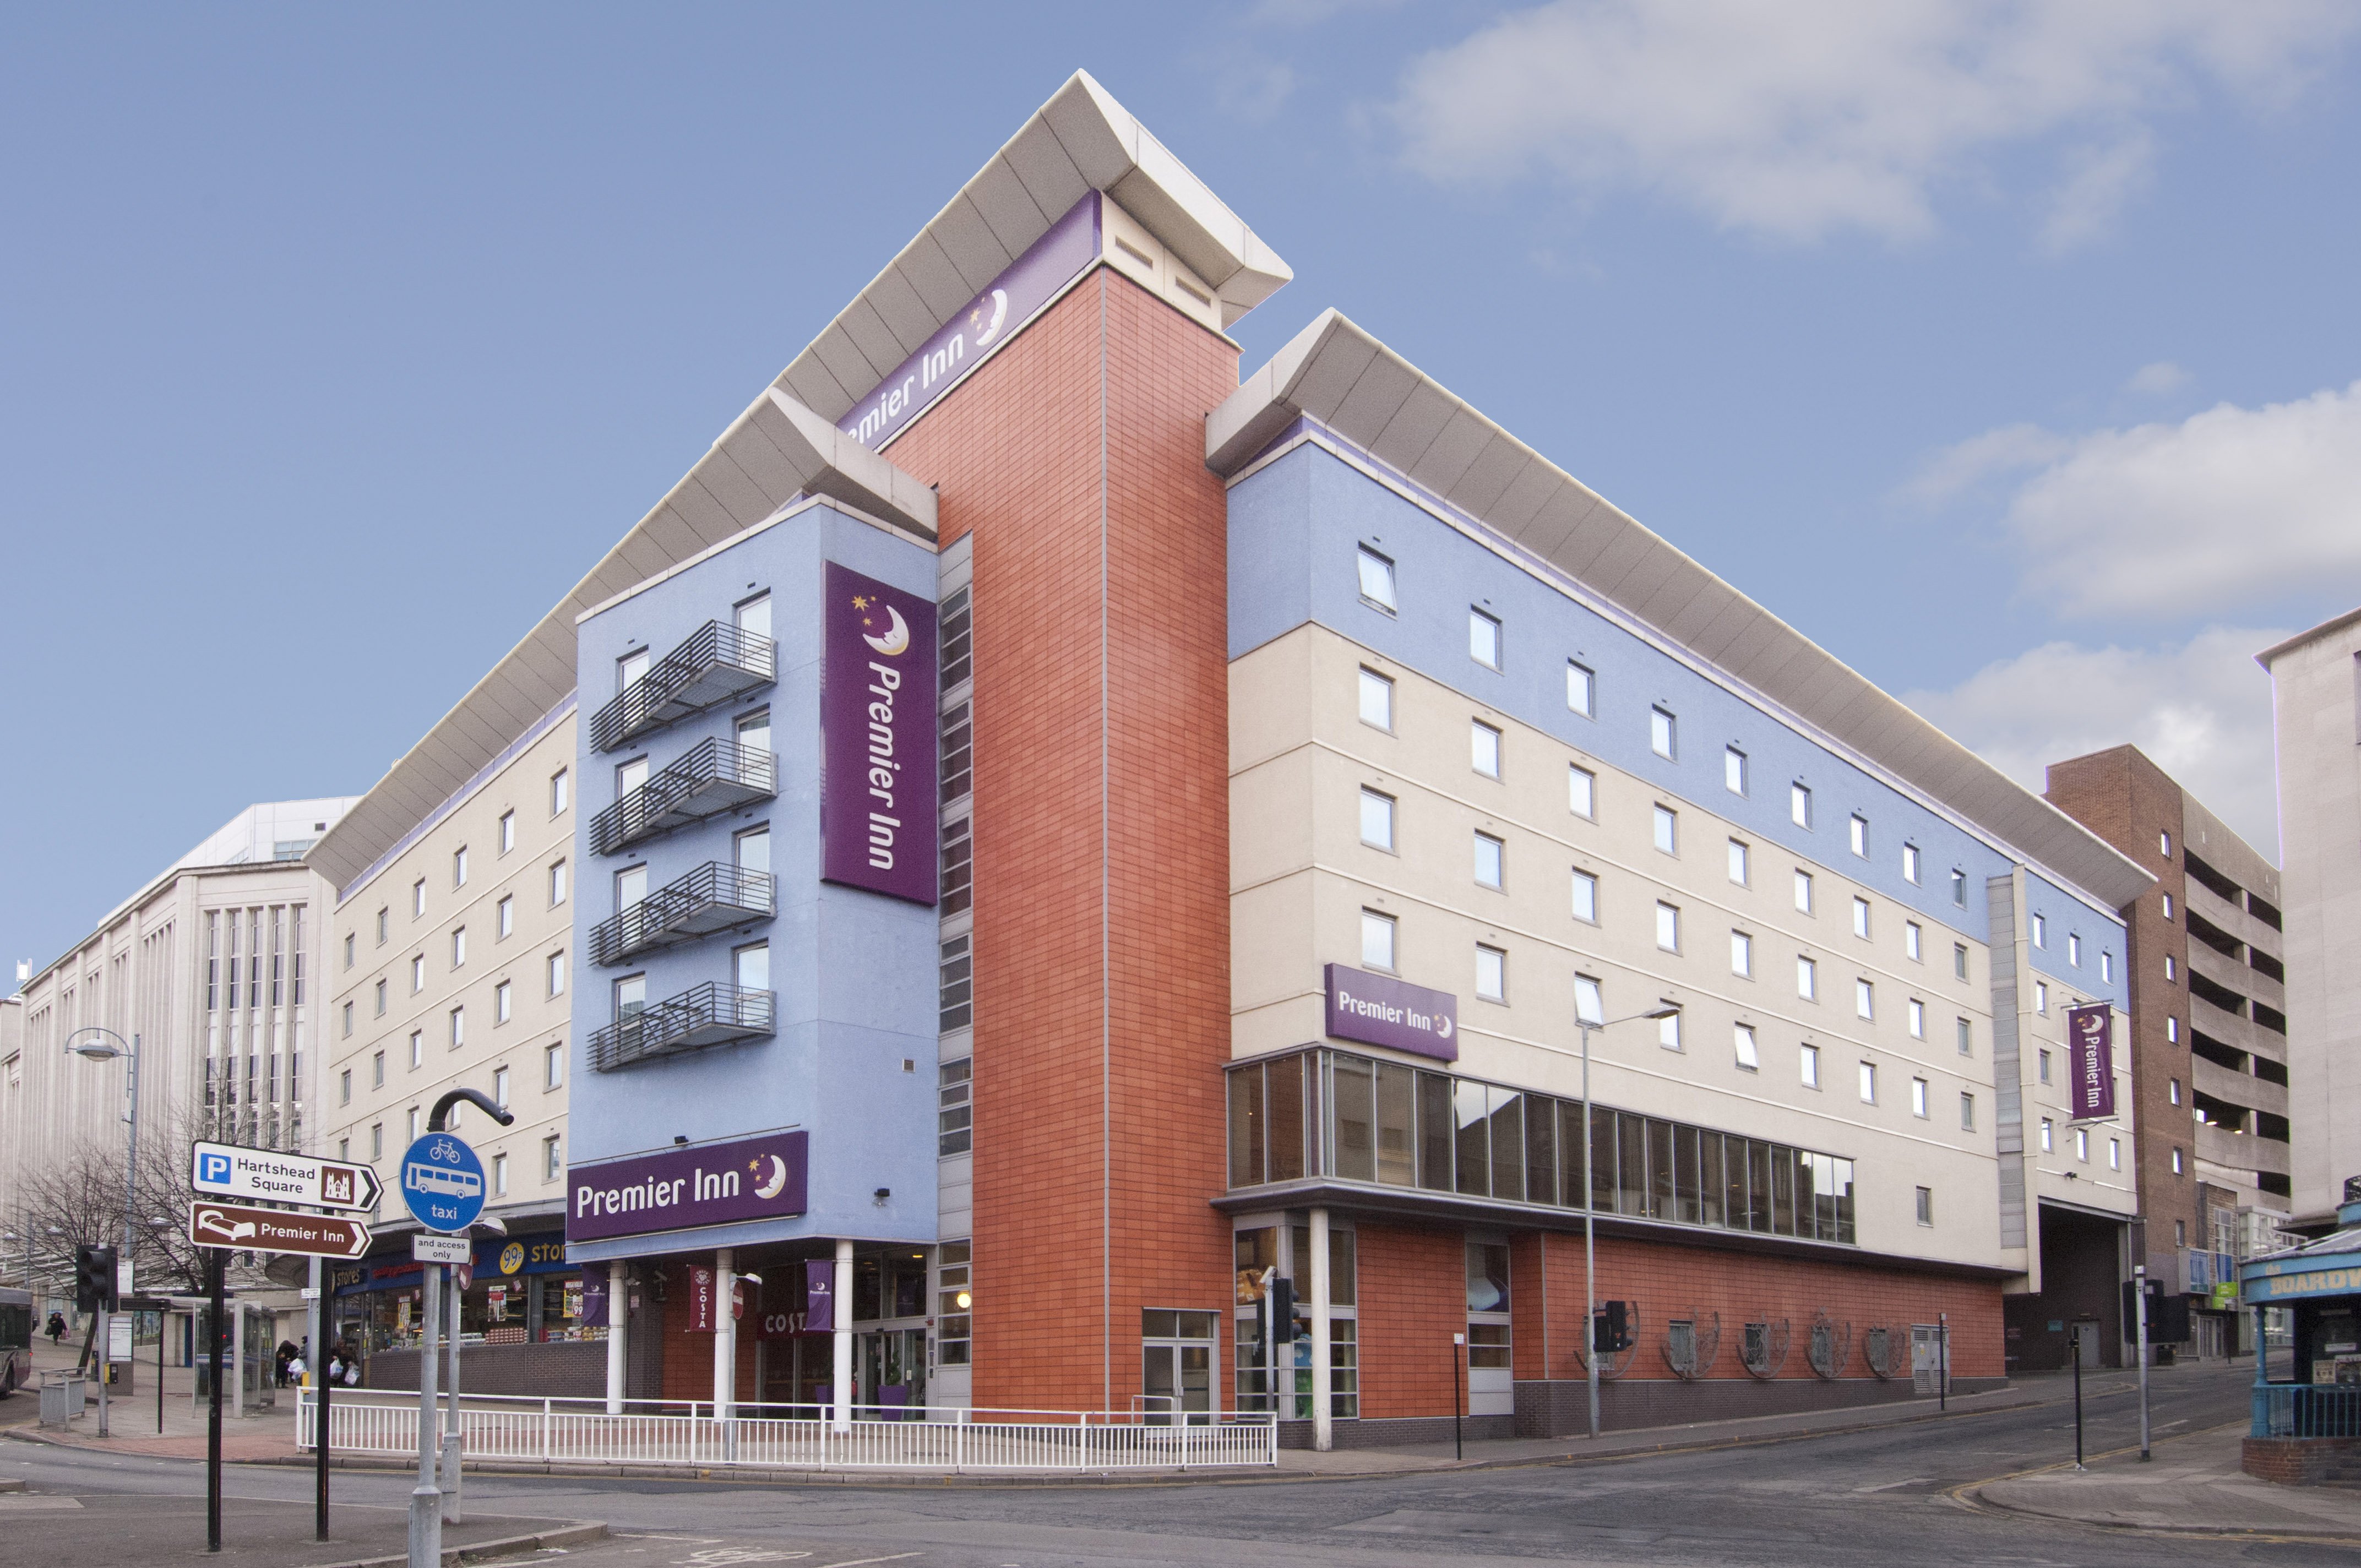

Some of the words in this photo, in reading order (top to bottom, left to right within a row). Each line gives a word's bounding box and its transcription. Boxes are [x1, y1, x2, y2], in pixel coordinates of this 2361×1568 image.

[848, 375, 915, 444] mier
[923, 334, 964, 389] Inn
[868, 661, 901, 808] Premier
[869, 812, 901, 870] Inn
[1339, 991, 1404, 1024] Premier
[1407, 1007, 1431, 1031] Inn
[2085, 1036, 2101, 1086] Premier
[2087, 1087, 2102, 1108] Inn
[208, 1156, 227, 1180] P
[238, 1158, 315, 1180] Hartshead
[251, 1177, 303, 1194] Square
[577, 1175, 686, 1218] Premier
[694, 1168, 739, 1202] Inn
[432, 1204, 457, 1219] taxi
[261, 1223, 318, 1240] Premier
[323, 1229, 345, 1243] Inn
[433, 1251, 451, 1260] only
[437, 1241, 466, 1249] access
[503, 1246, 523, 1269] 99p
[699, 1287, 708, 1328] COSTA
[765, 1312, 805, 1333] COST
